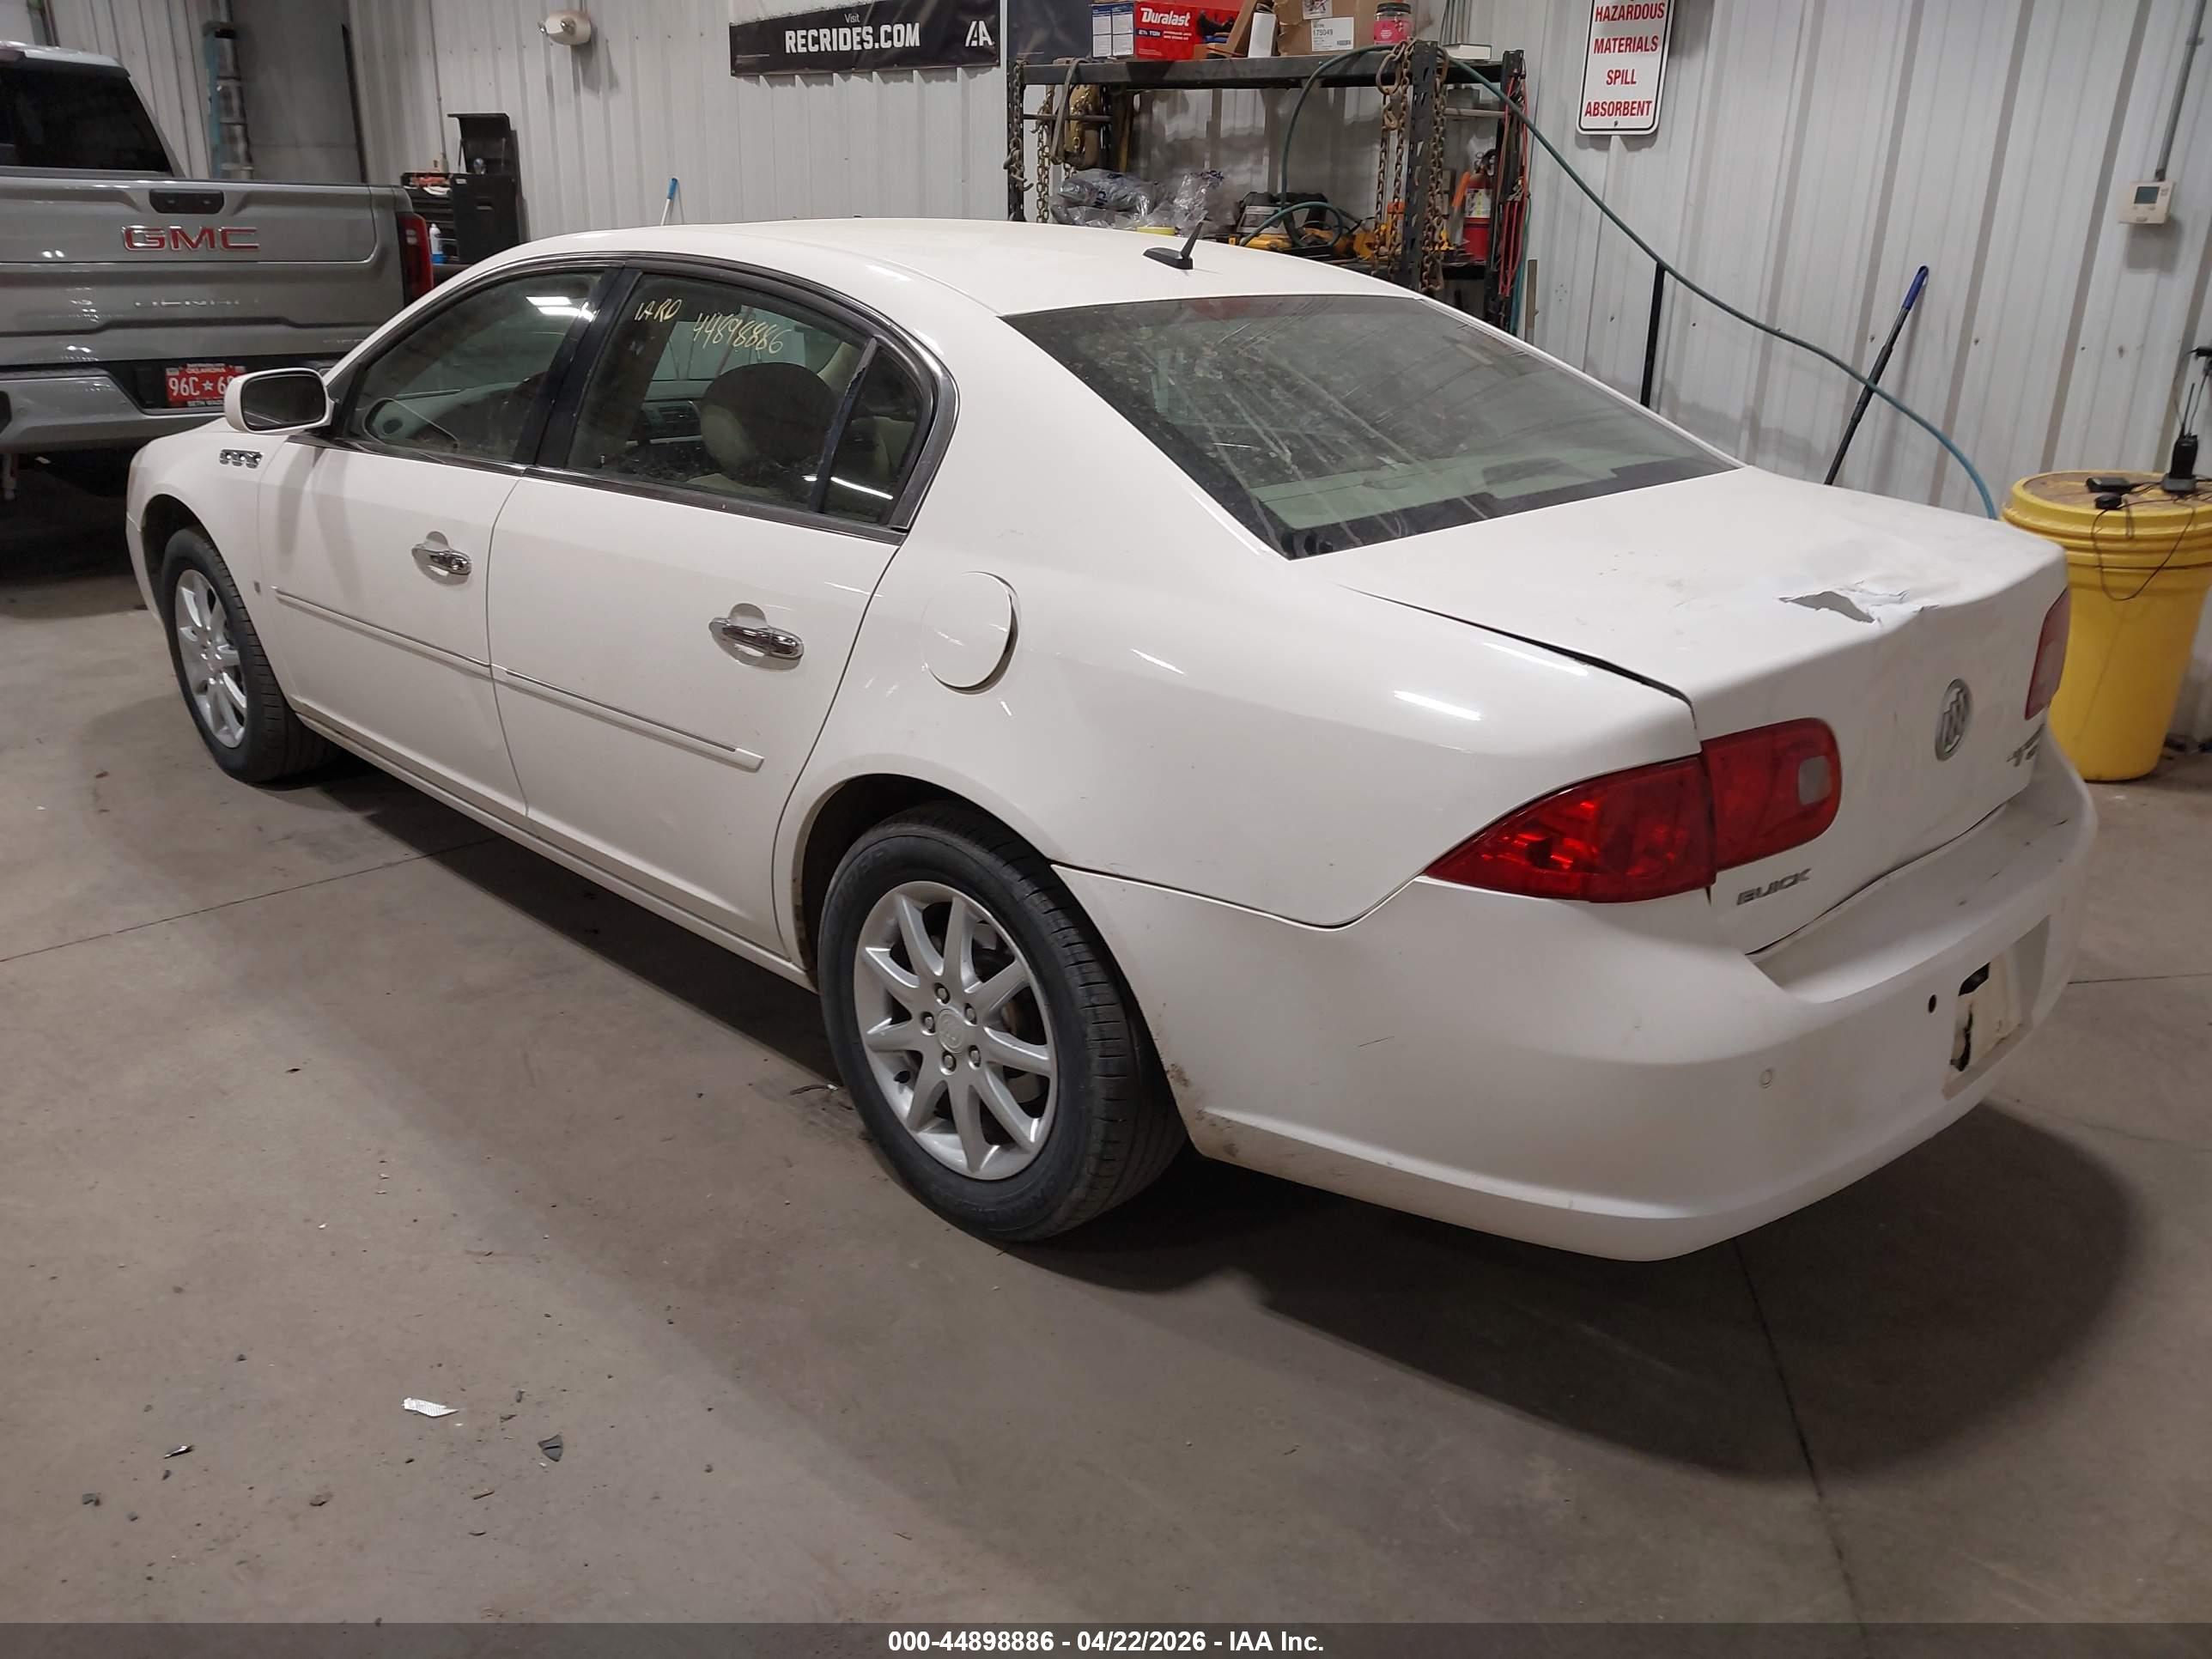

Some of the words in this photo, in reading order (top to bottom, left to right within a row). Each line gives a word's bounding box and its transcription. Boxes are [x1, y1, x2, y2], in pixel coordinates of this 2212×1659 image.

[844, 13, 860, 24] Visit
[1140, 7, 1191, 27] Duralast
[1595, 3, 1665, 21] HAZARDOUS
[785, 22, 921, 53] RECRIDES.COM
[1594, 35, 1659, 54] MATERIALS
[1606, 69, 1637, 85] SPILL
[1584, 100, 1653, 117] ABSORBENT
[121, 224, 260, 252] GMC
[693, 312, 792, 355] 44898886
[168, 376, 201, 397] 96C
[1736, 867, 1812, 906] BUICK
